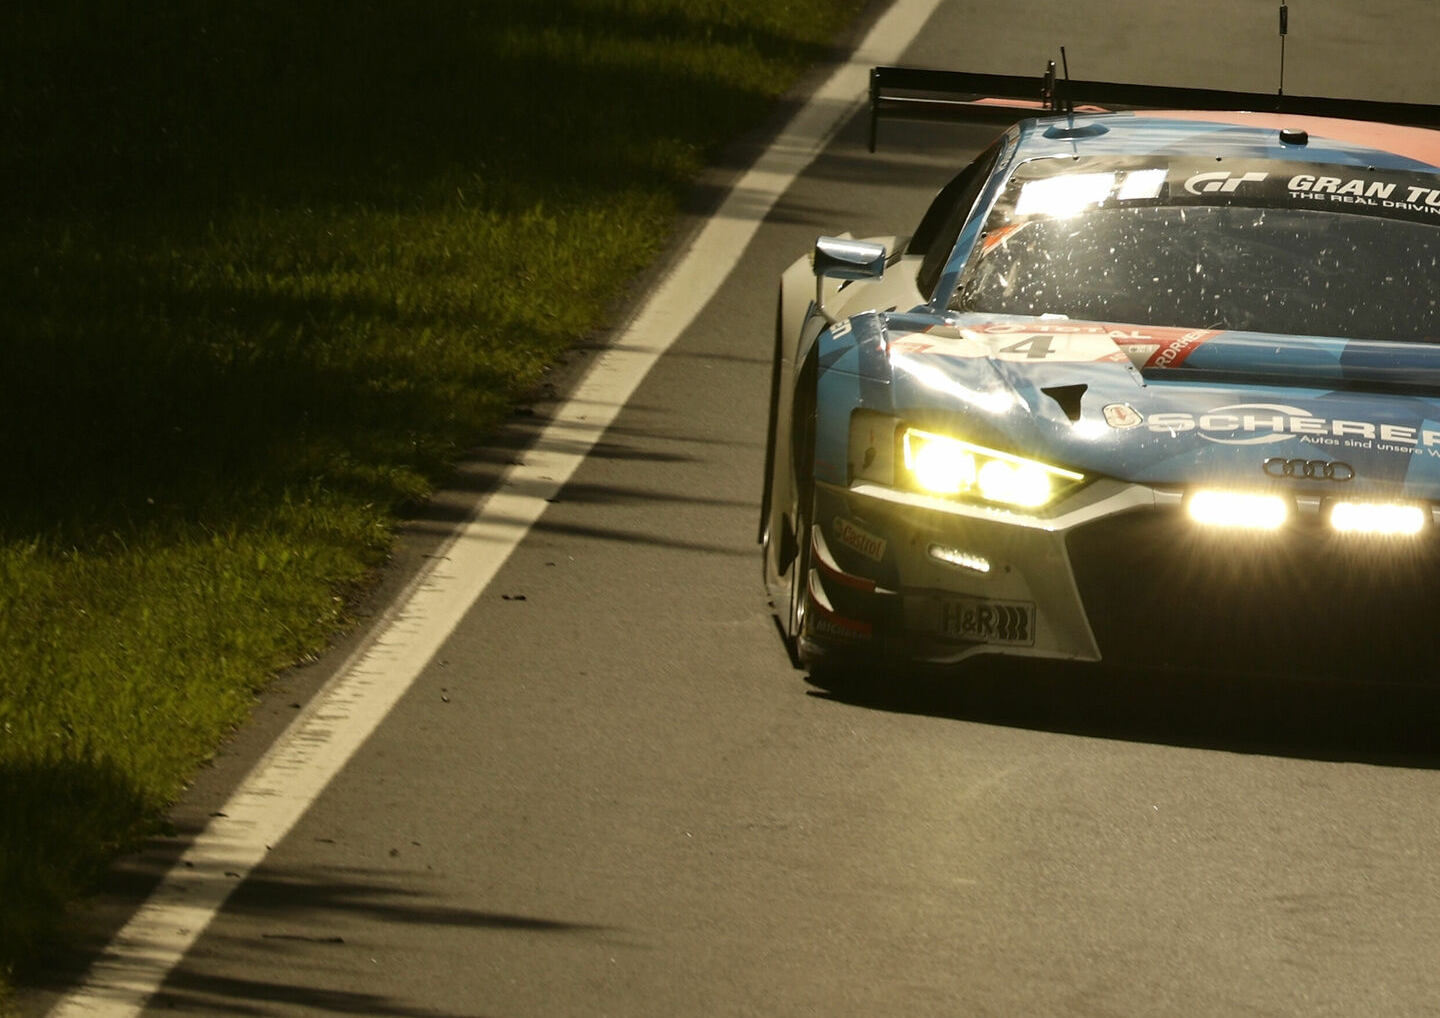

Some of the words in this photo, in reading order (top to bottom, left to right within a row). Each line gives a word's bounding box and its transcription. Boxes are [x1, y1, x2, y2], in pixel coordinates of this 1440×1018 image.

[1287, 174, 1399, 200] GRAN
[1289, 192, 1327, 202] THE
[1330, 194, 1379, 206] REAL
[999, 334, 1055, 360] 4
[1300, 435, 1339, 446] Autos
[1344, 439, 1372, 450] sind
[1377, 444, 1422, 456] unsere
[842, 525, 883, 559] Castrol
[942, 602, 994, 635] H&R
